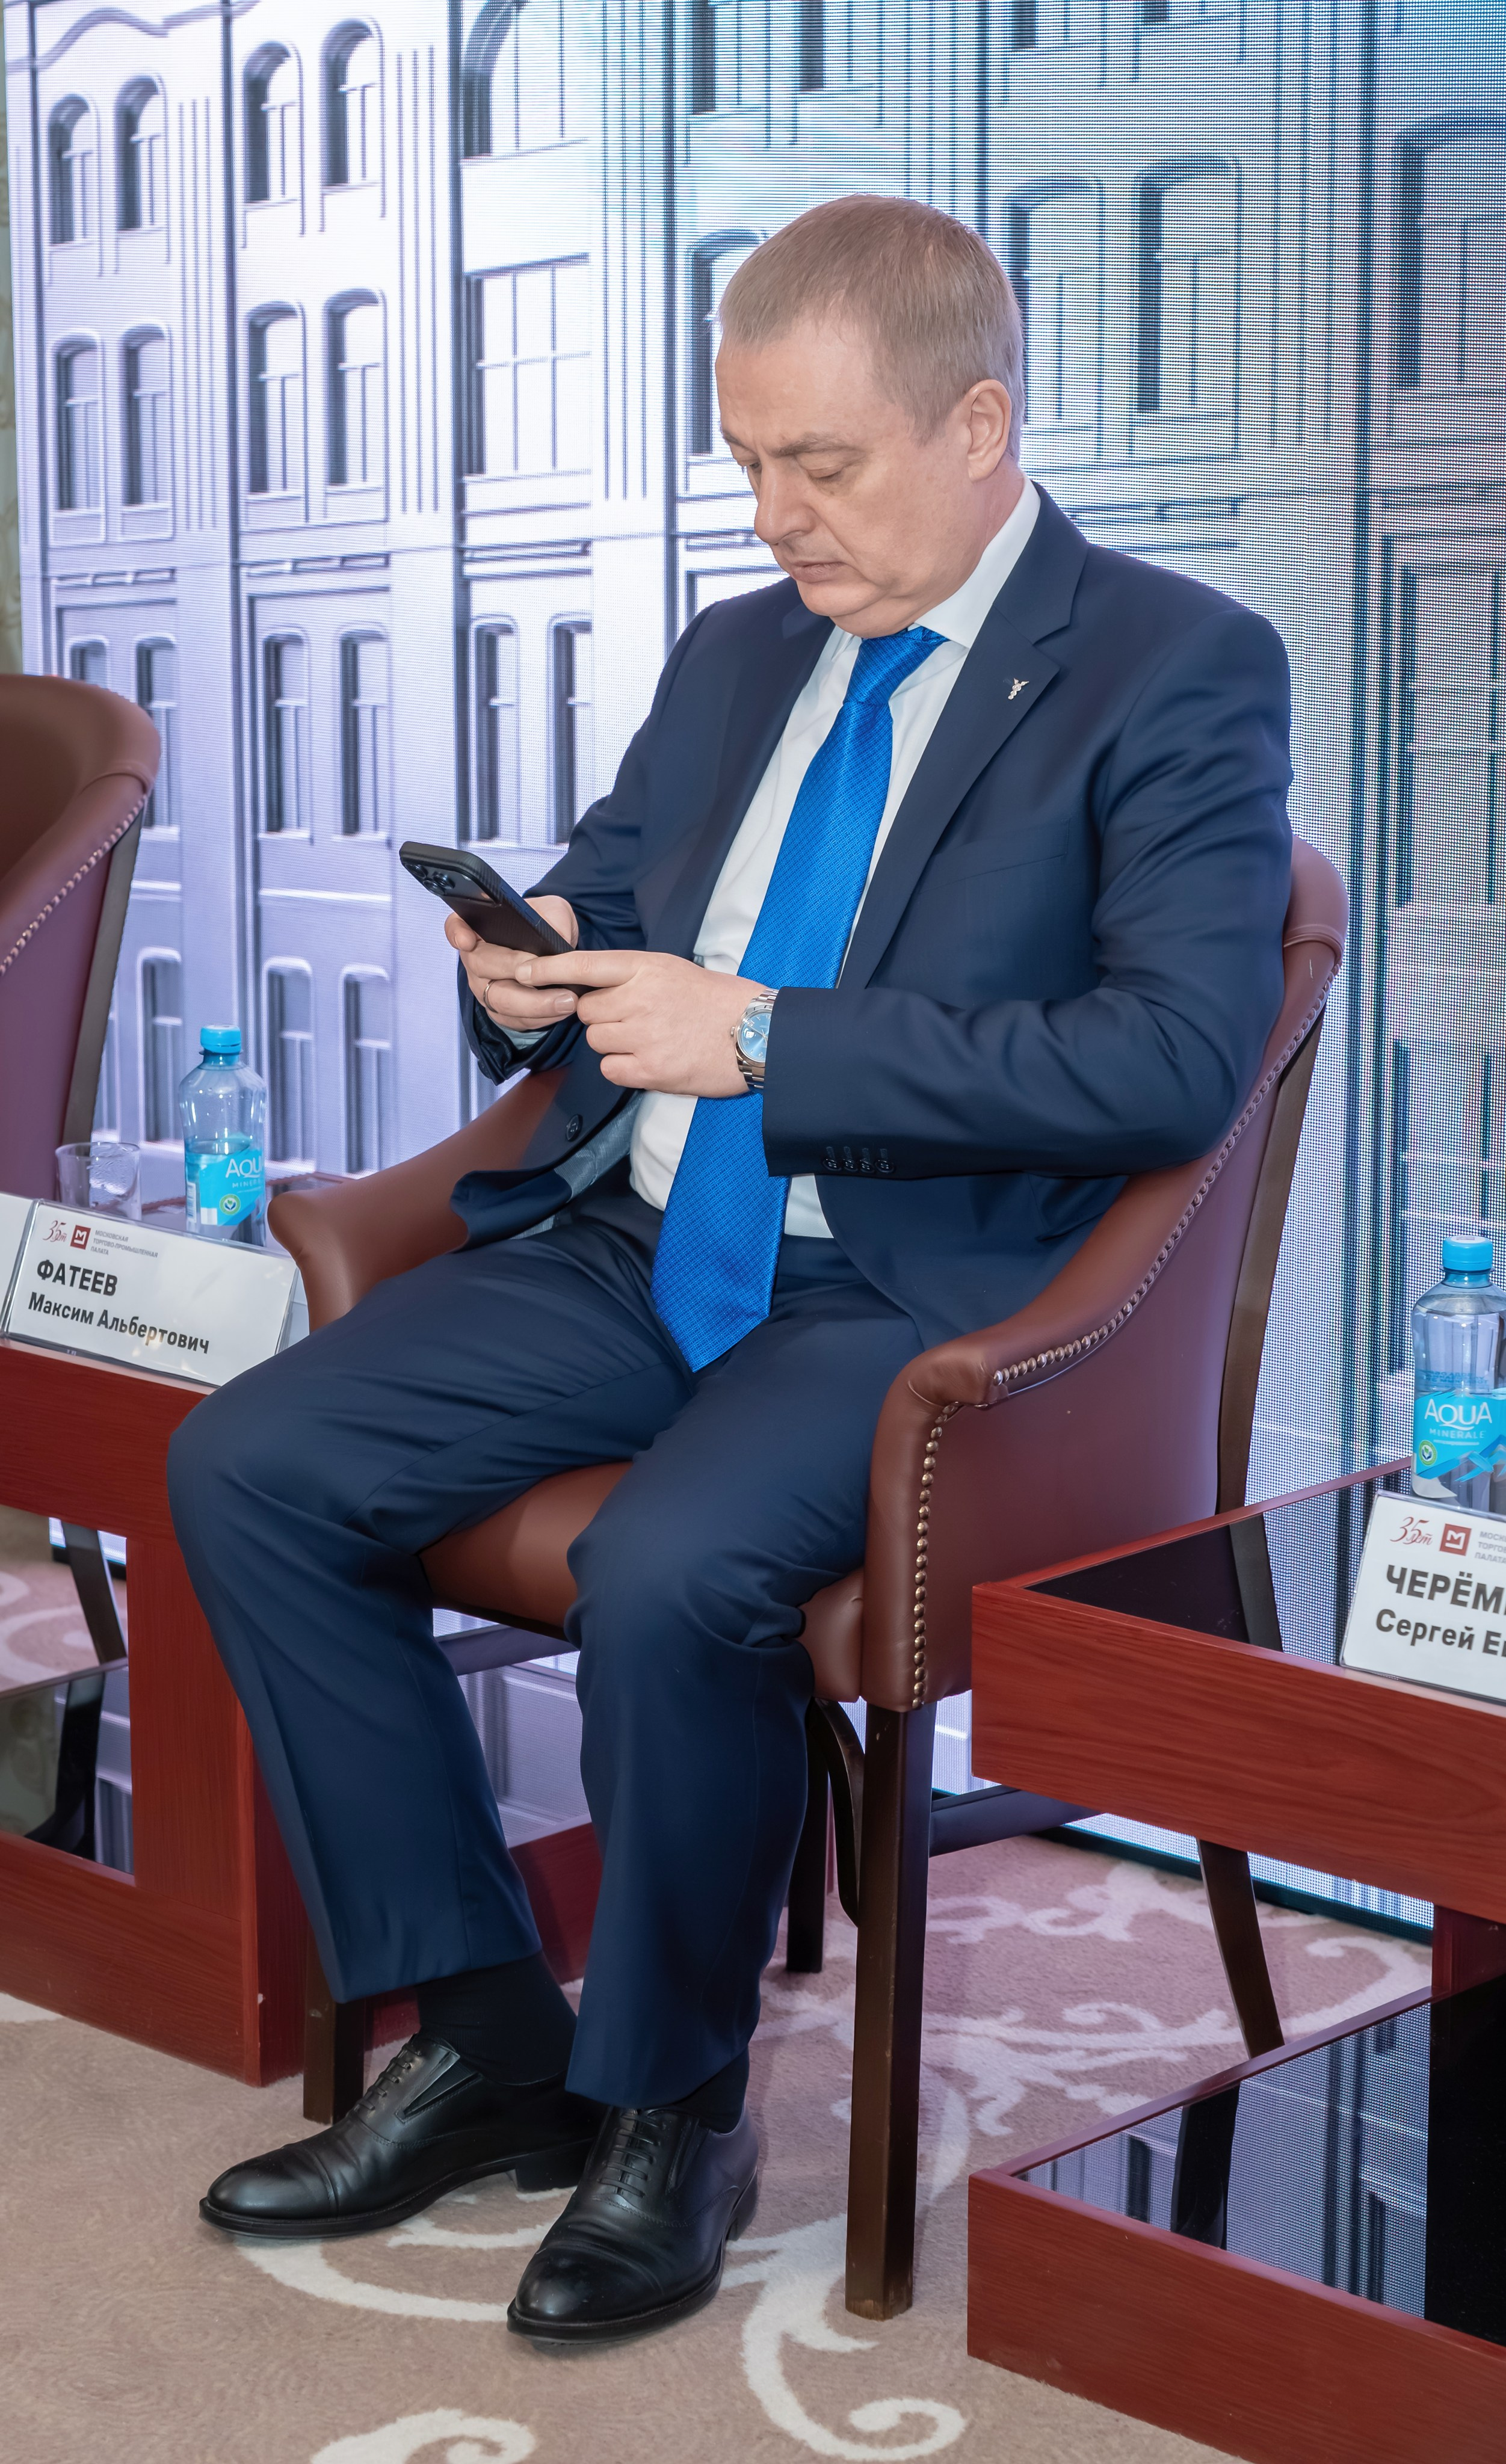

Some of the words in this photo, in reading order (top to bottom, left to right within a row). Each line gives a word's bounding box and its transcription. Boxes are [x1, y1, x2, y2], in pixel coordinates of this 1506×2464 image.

[90, 1246, 109, 1255] ПАЛАТА
[93, 1238, 158, 1258] ТОРГОВО-ПРОМЫШЛЕННАЯ
[95, 1230, 128, 1242] МОСКОВСКАЯ
[37, 1260, 118, 1296] ФАТЕЕВ
[28, 1292, 94, 1325] Максим
[96, 1310, 209, 1354] Альбертович
[1424, 1399, 1493, 1431] AQUA
[1430, 1428, 1487, 1439] MINERALE
[1386, 1564, 1506, 1616] ЧЕРЁМ
[1375, 1609, 1475, 1651] Сергей
